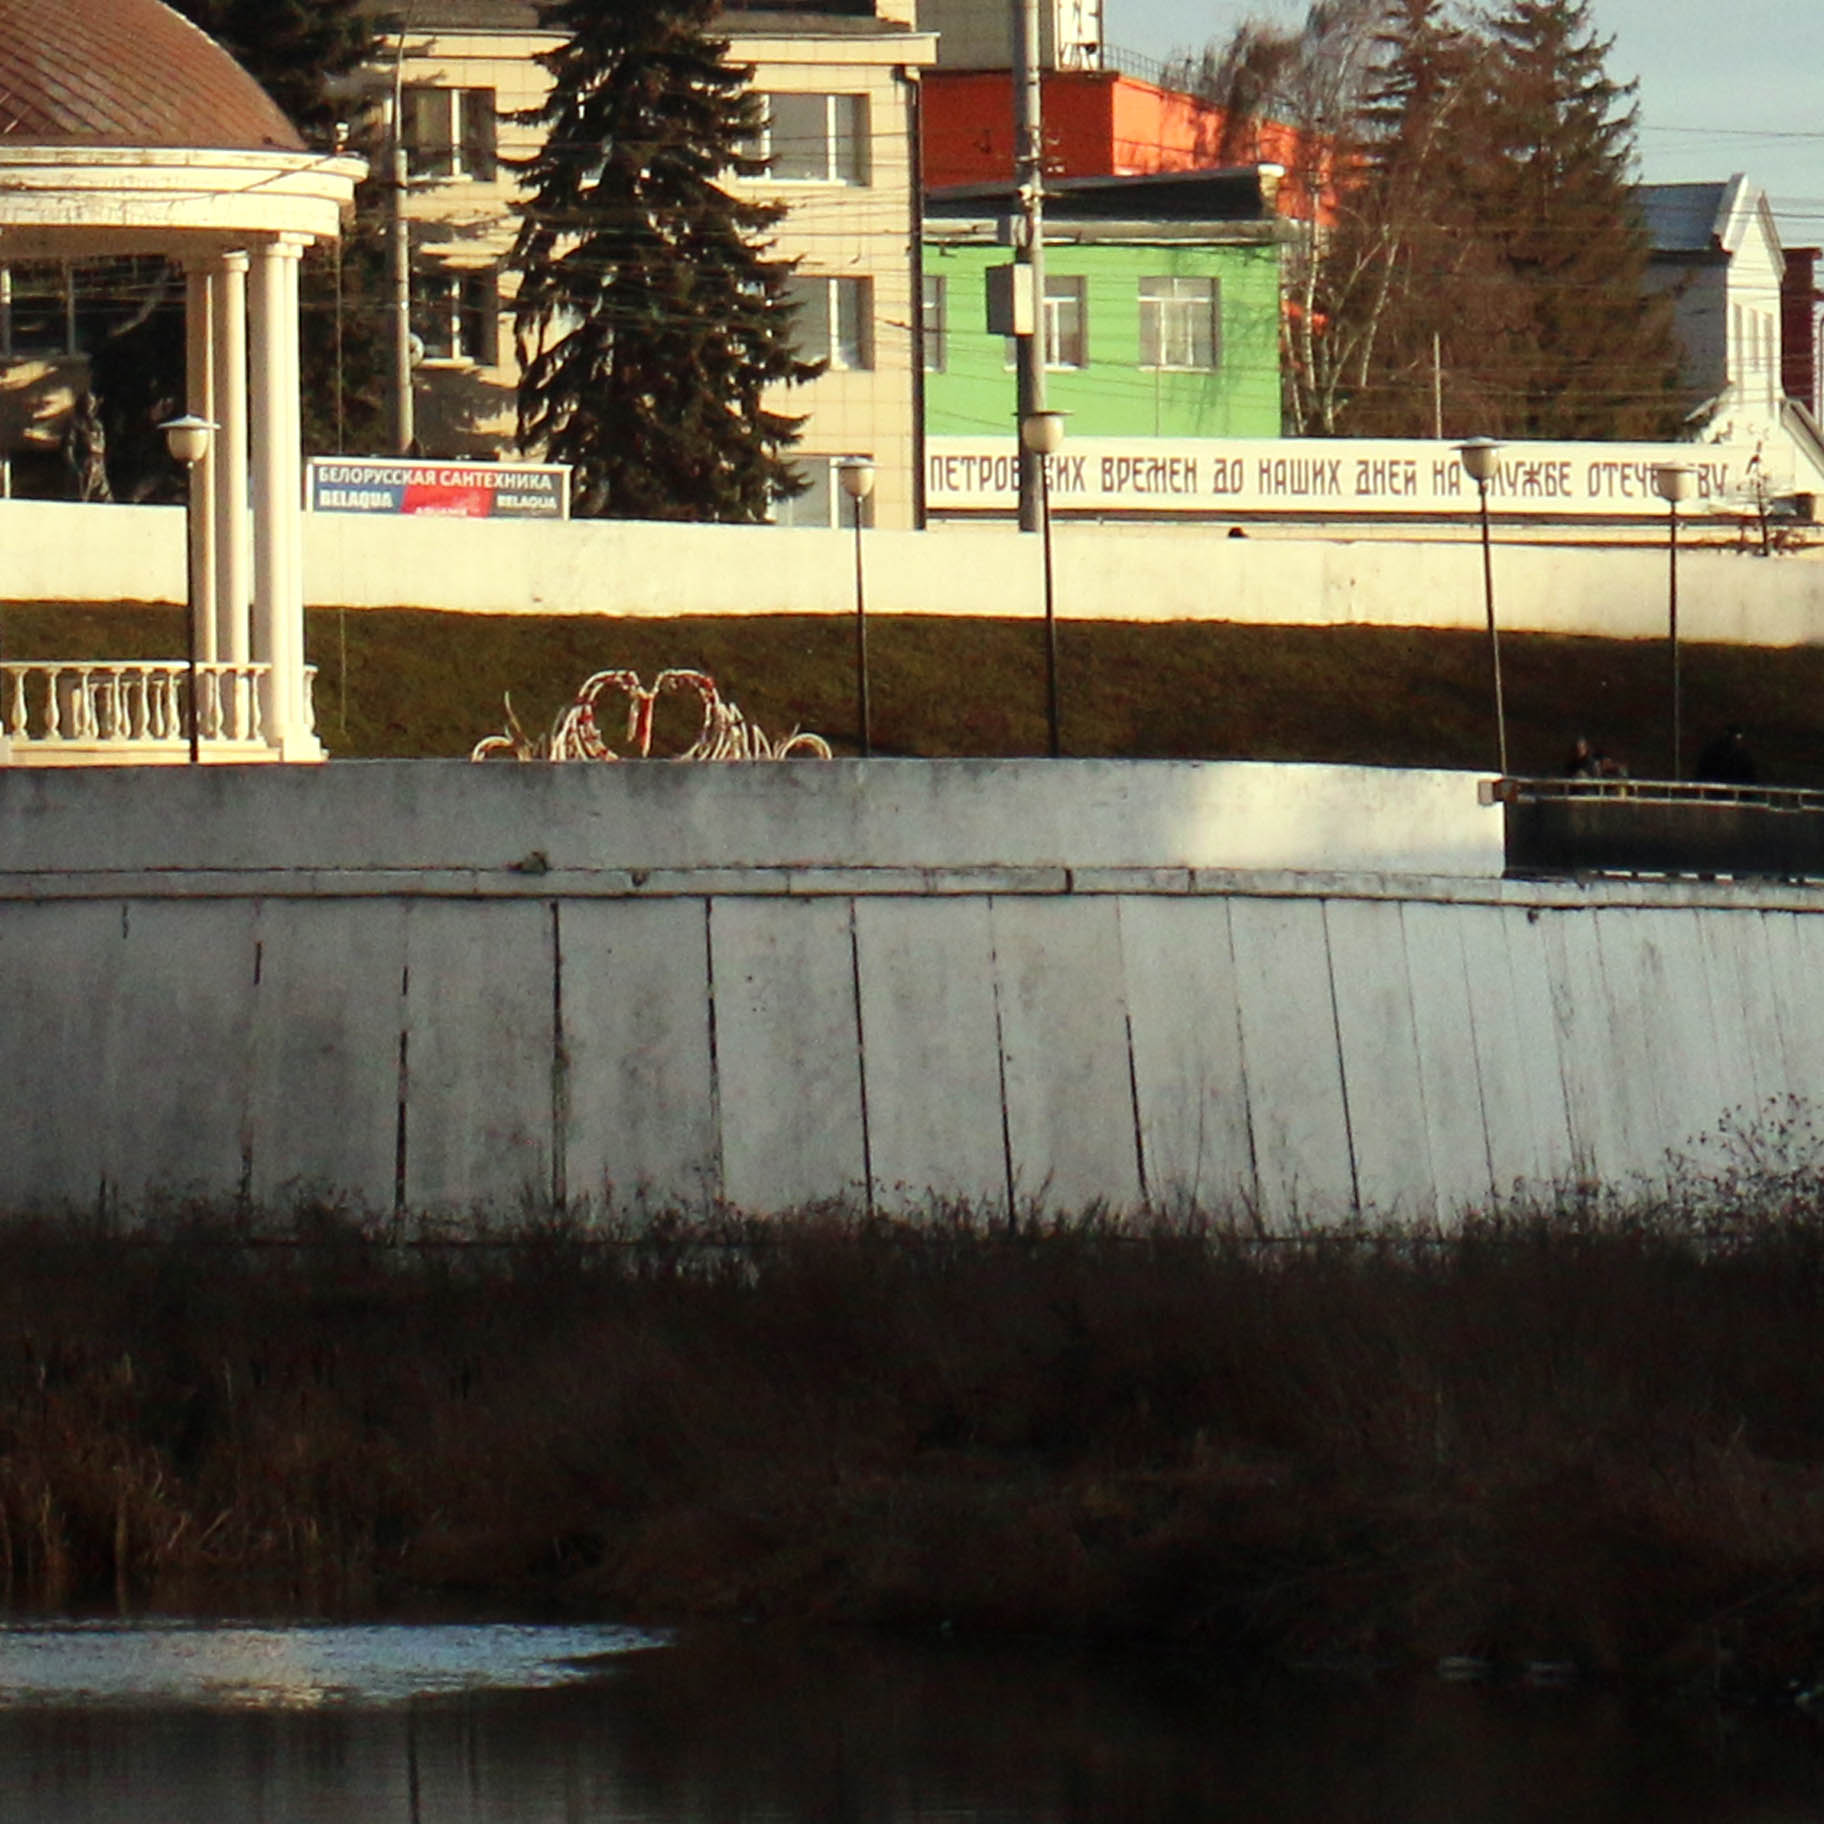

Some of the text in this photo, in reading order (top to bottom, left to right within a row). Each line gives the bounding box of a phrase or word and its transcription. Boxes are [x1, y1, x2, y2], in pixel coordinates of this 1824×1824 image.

[318, 466, 552, 490] БЕЛОРУССКАЯ САНТЕХНИКА
[930, 456, 1728, 498] ПЕТРОВКИХ ВРЕМЕН ДО НАШИХ ДНЕЙ НА ЛУЖБЕ ОТЕЧЕВУ
